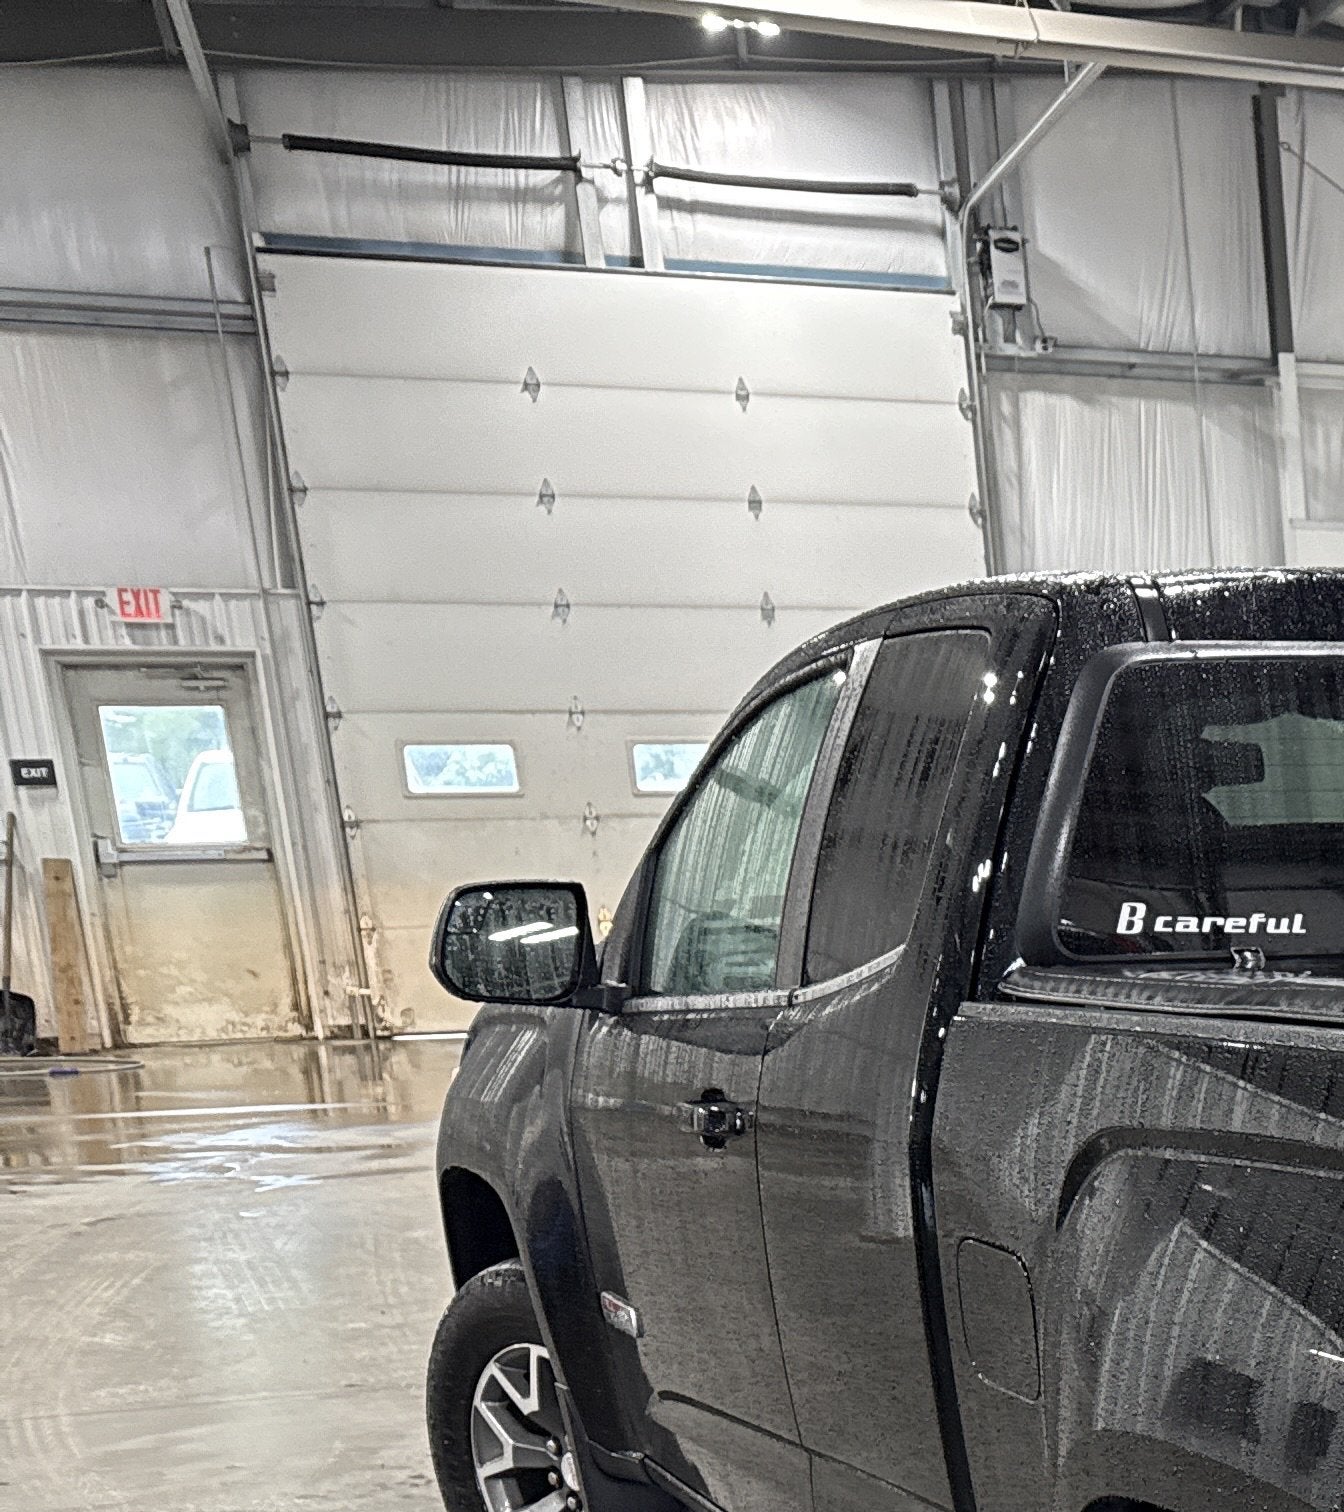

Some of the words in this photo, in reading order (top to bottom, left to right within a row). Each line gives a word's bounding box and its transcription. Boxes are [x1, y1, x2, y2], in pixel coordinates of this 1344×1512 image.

[117, 587, 161, 619] EXIT
[20, 766, 49, 779] EXIT
[1116, 902, 1147, 934] B
[1153, 913, 1307, 934] careful
